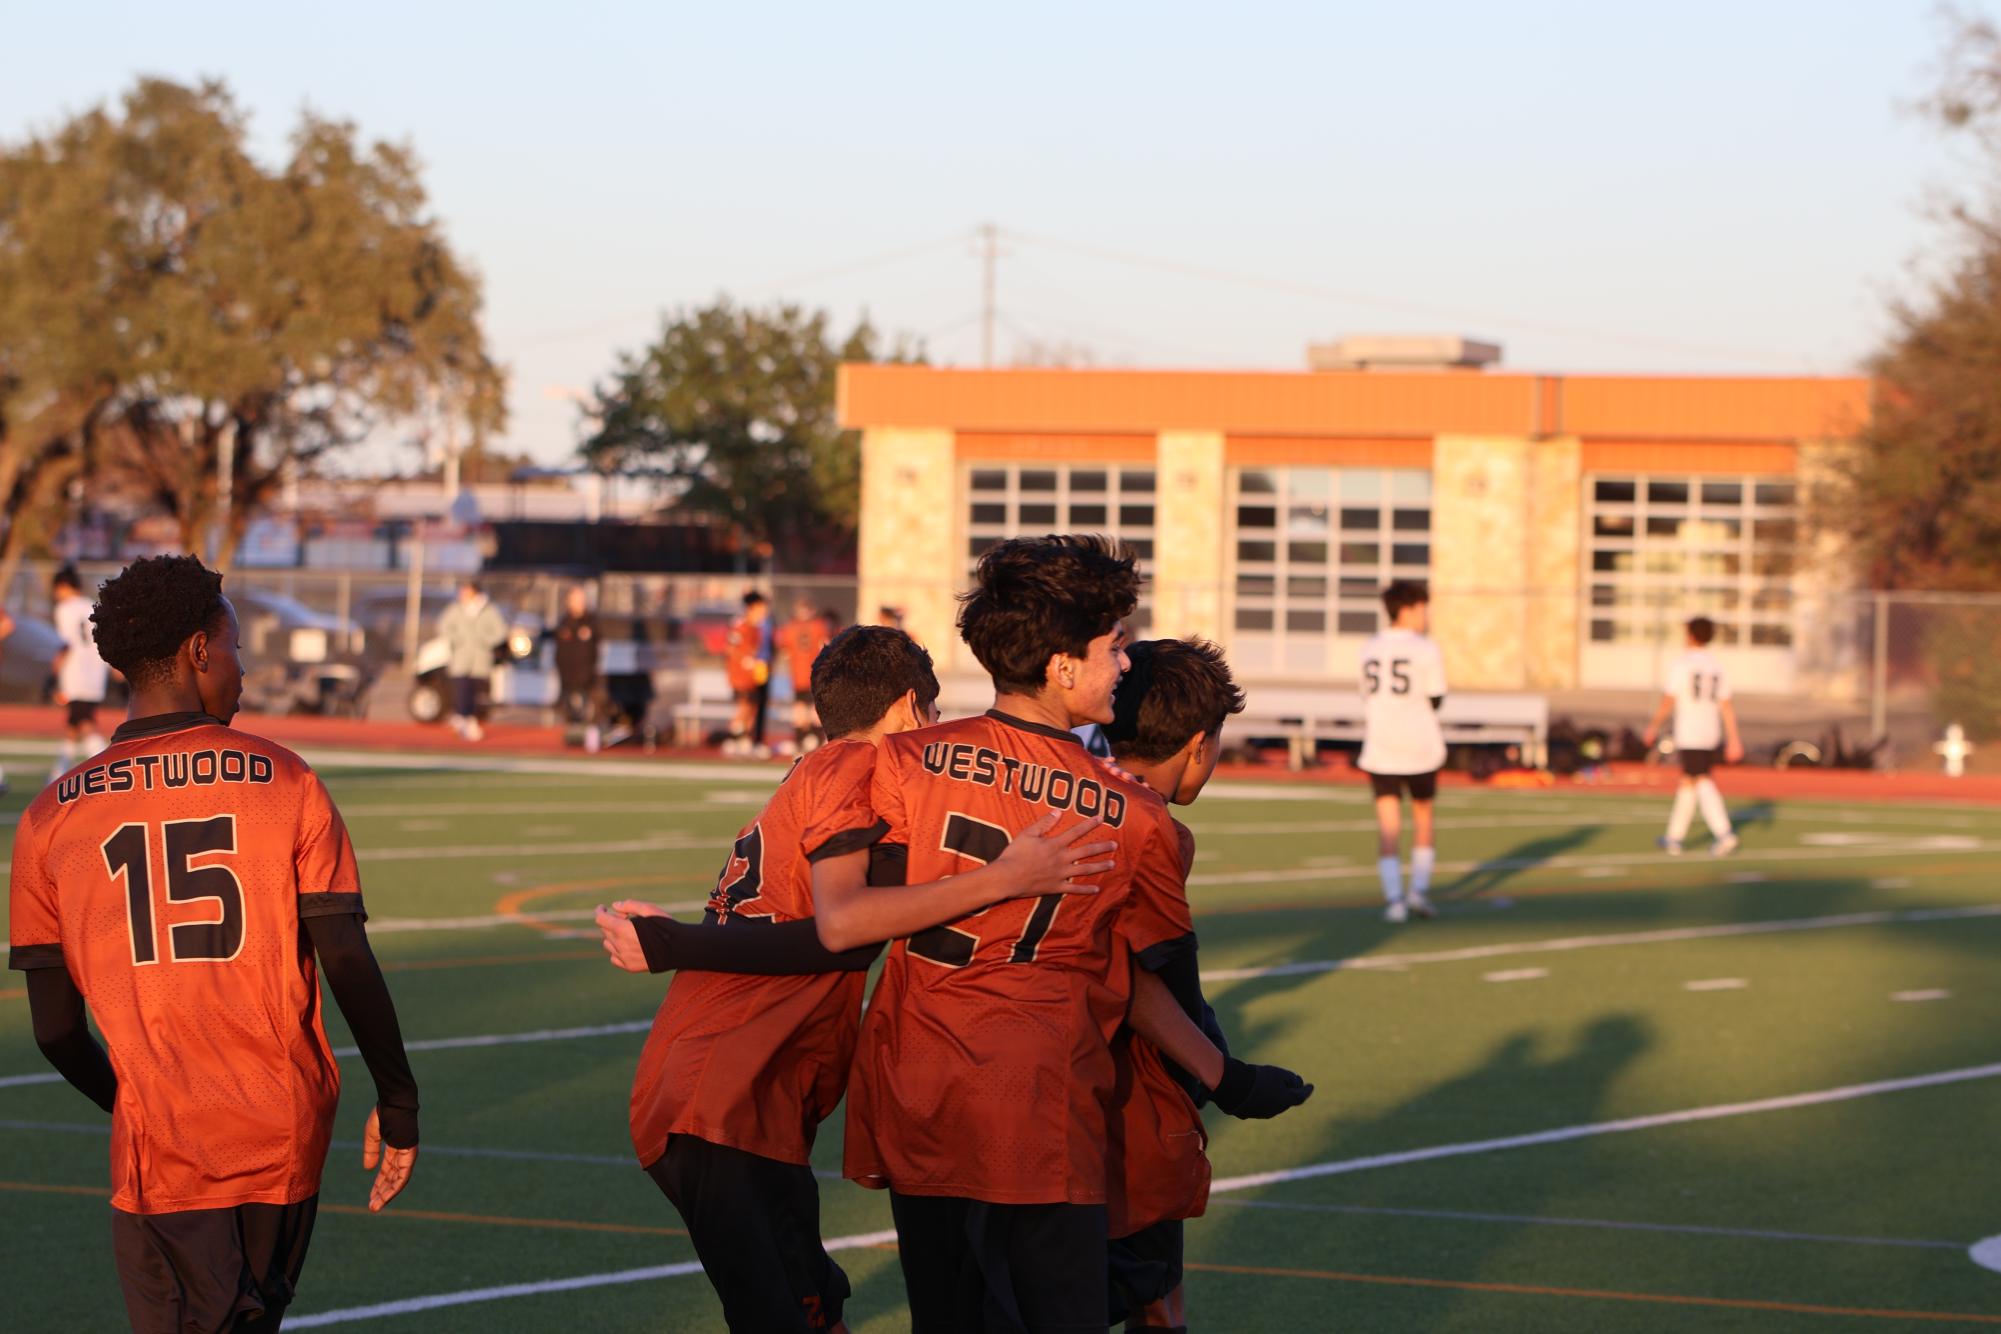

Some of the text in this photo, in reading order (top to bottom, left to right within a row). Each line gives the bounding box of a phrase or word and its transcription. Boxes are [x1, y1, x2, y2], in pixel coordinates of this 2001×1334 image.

[57, 748, 275, 805] WESTWOOD
[922, 741, 1128, 830] WESTWOOD
[99, 813, 247, 967] 15
[704, 820, 776, 925] 2
